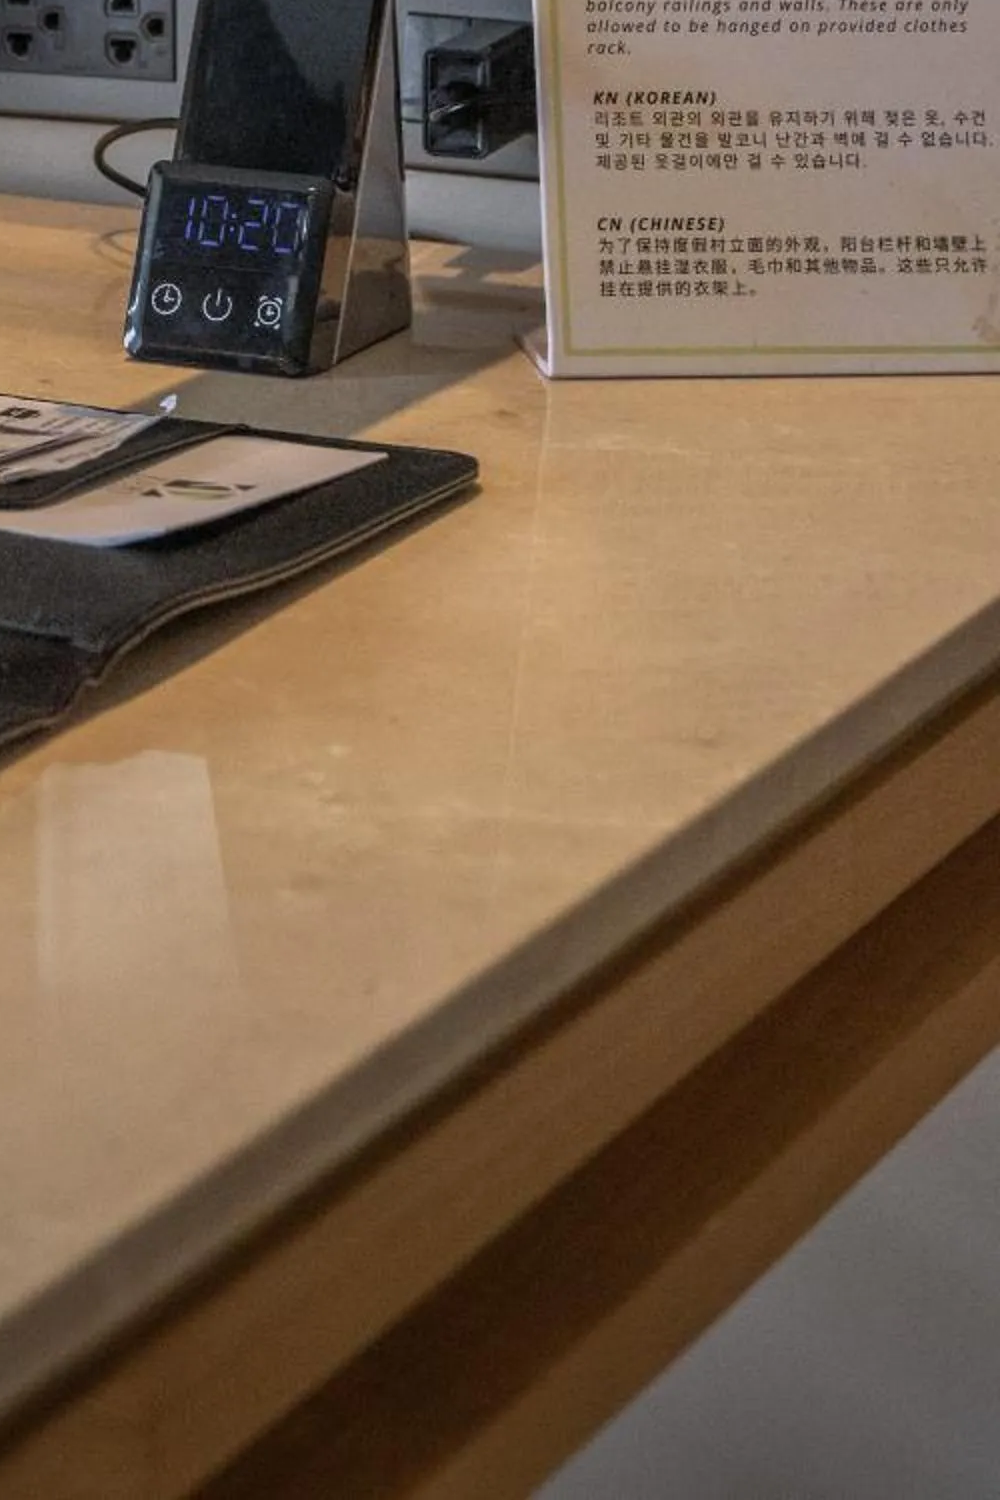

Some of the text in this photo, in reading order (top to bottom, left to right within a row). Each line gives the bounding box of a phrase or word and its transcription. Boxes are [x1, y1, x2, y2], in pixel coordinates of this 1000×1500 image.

[894, 0, 924, 13] are
[586, 17, 968, 37] allowed to be hanged on provided clothes
[586, 39, 632, 56] rack.
[592, 89, 718, 108] KN (KOREAN)
[184, 194, 303, 254] 10:20
[596, 215, 726, 235] CN (CHINESE)
